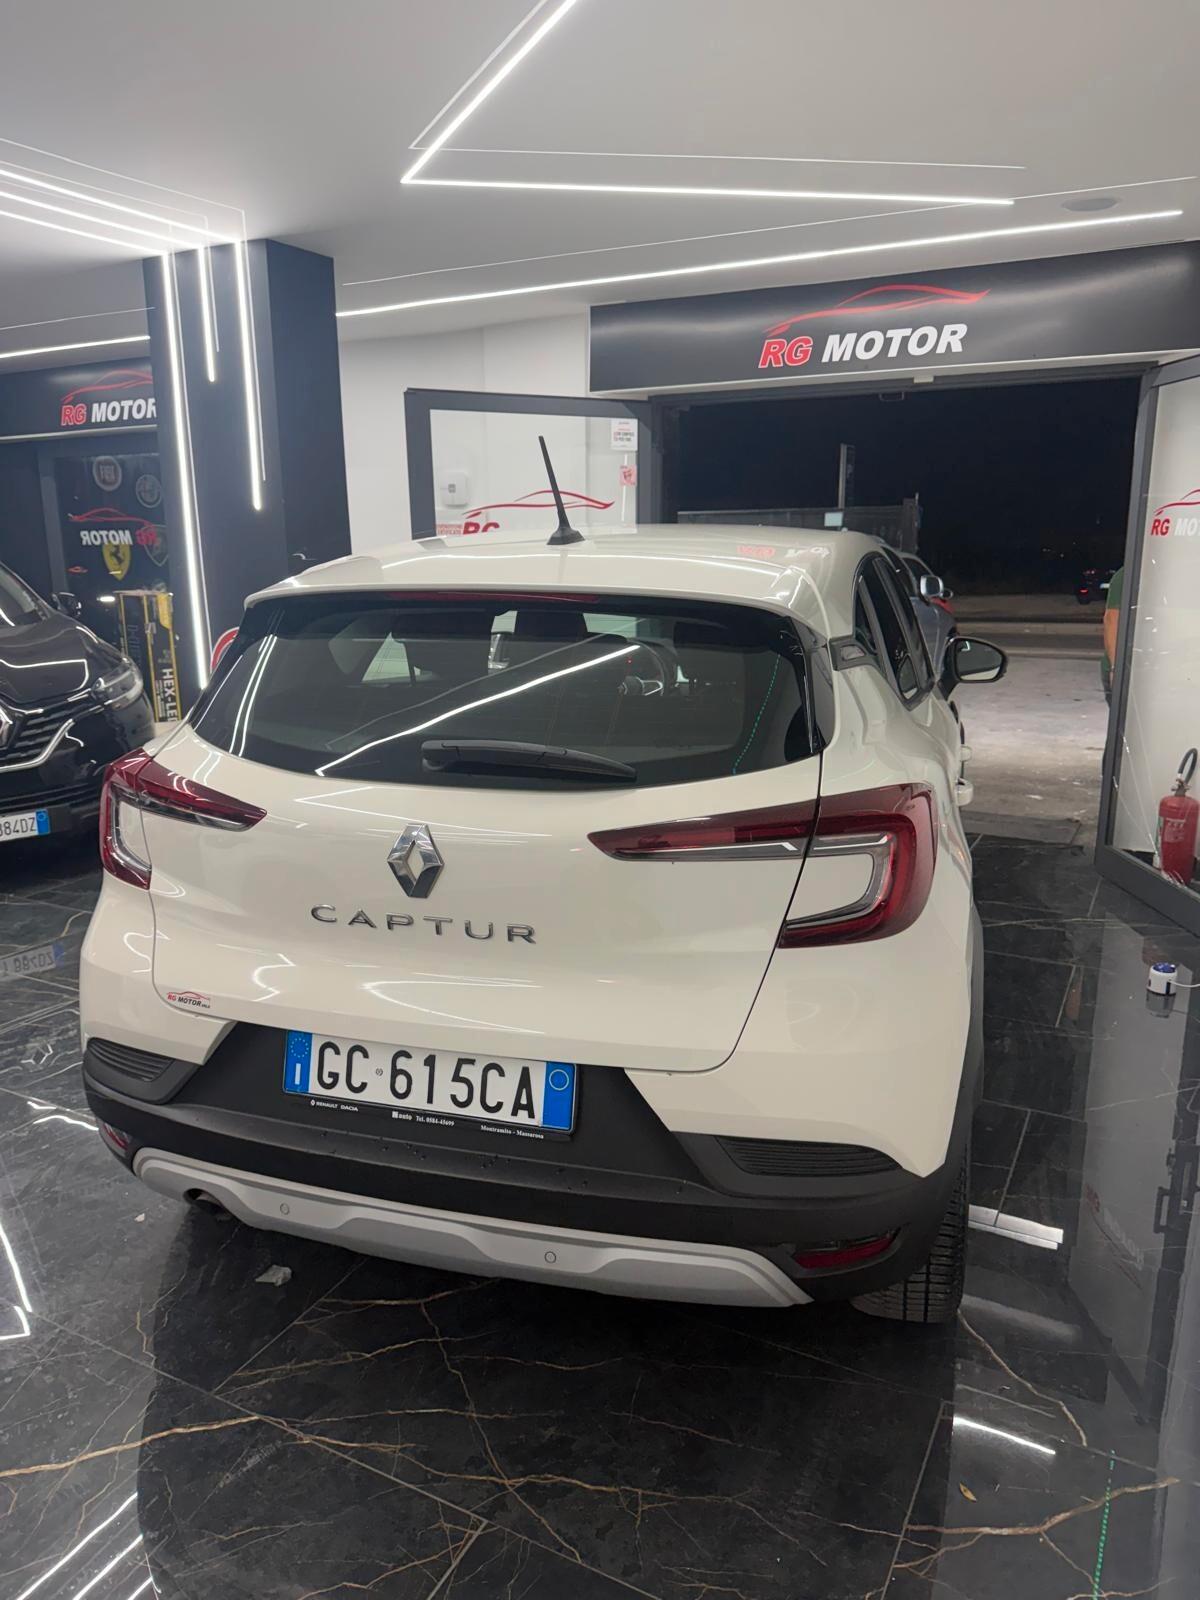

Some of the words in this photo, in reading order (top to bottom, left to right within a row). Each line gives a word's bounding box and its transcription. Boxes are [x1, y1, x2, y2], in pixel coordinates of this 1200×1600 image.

[758, 335, 813, 368] RG
[821, 323, 968, 363] MOTOR
[60, 403, 87, 426] RG
[91, 397, 157, 423] MOTOR
[1150, 518, 1170, 536] RG
[162, 668, 178, 722] HEX-LE
[311, 903, 536, 945] CAPTUR
[178, 996, 202, 1007] MOTOR
[318, 1041, 369, 1094] GC
[390, 1050, 535, 1119] 615CA
[315, 1101, 338, 1109] RENAULT
[340, 1104, 359, 1112] DACIA
